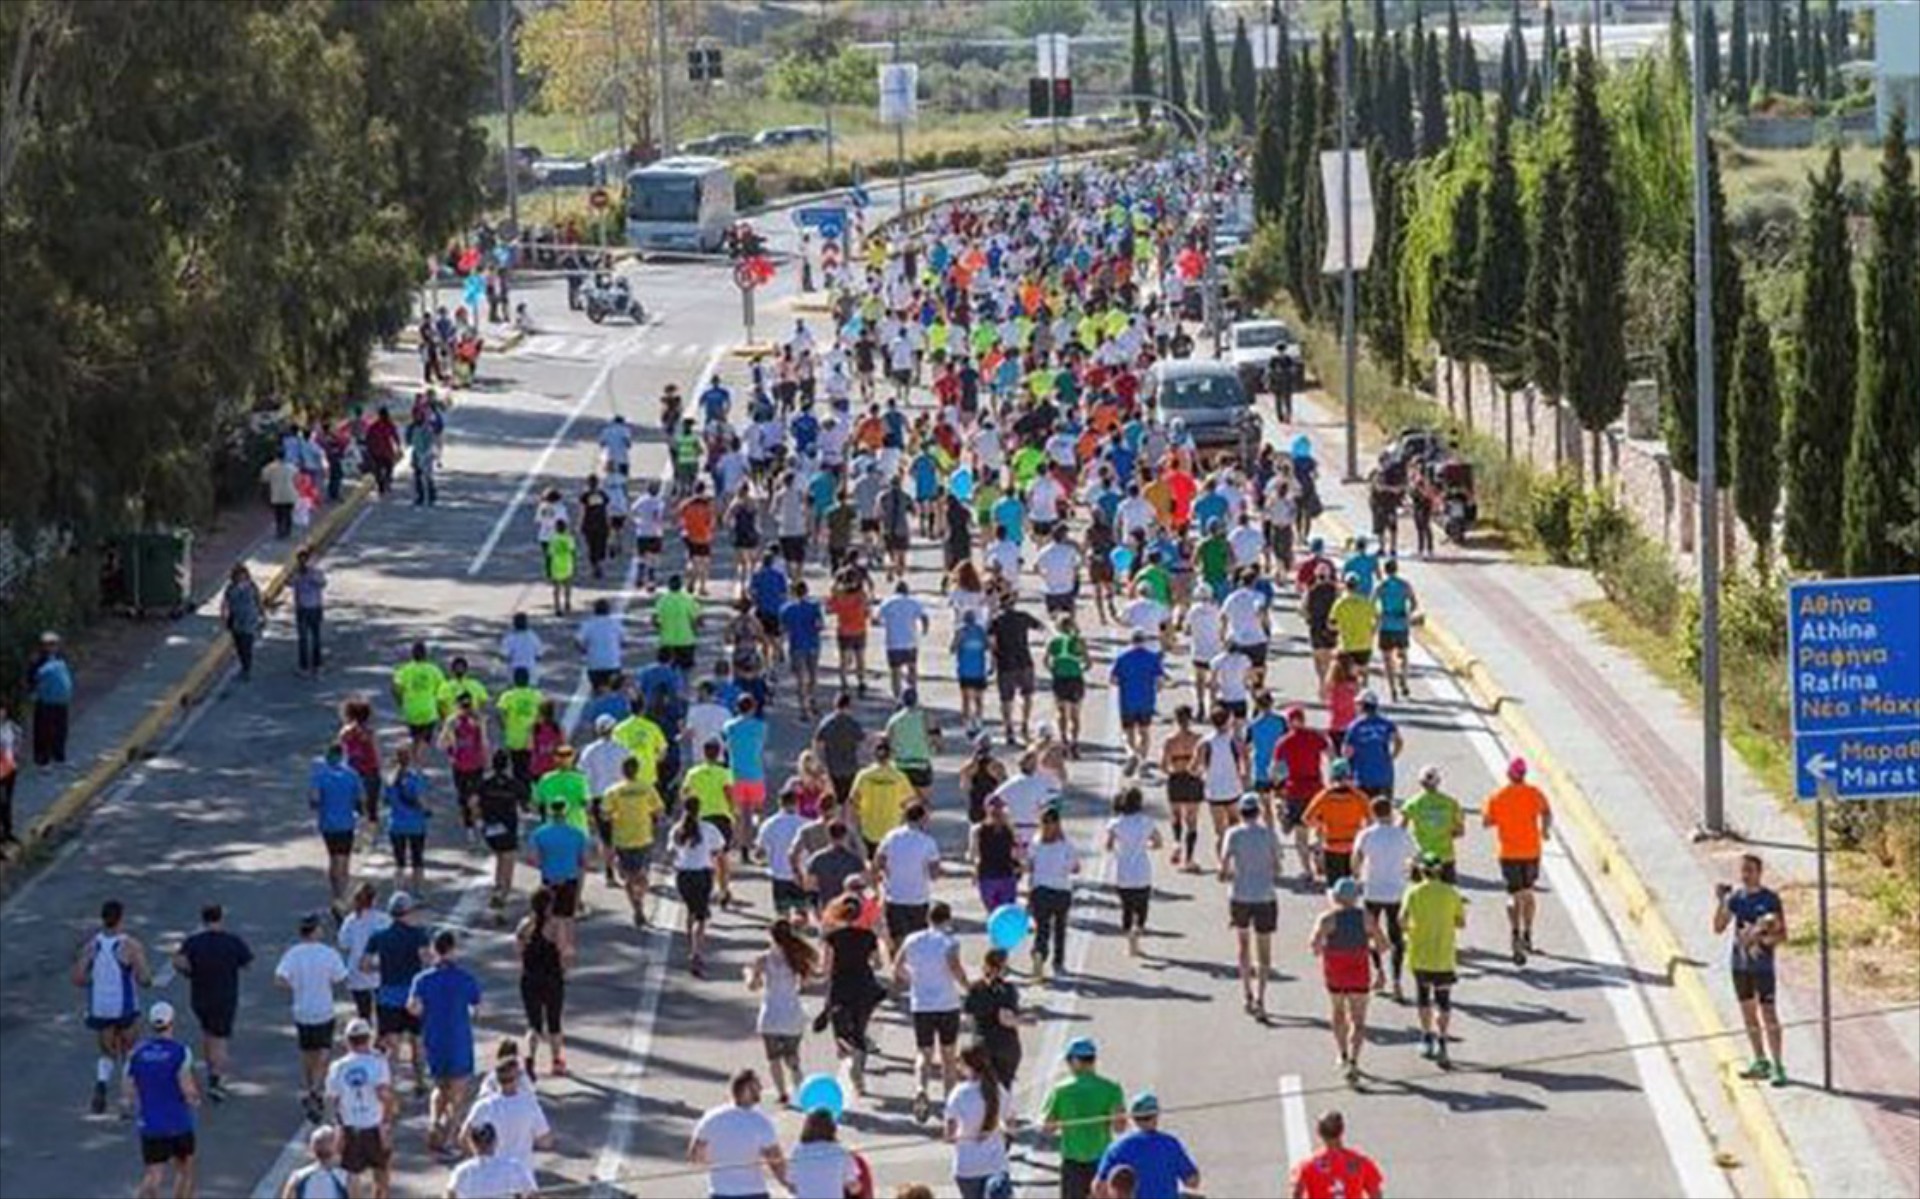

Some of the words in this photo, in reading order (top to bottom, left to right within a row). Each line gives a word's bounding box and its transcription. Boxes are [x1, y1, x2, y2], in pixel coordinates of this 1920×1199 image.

[1800, 592, 1872, 618] Αθήνα
[1800, 621, 1878, 641] Athina
[1801, 672, 1878, 693] Rafina
[1843, 766, 1918, 787] Marat
